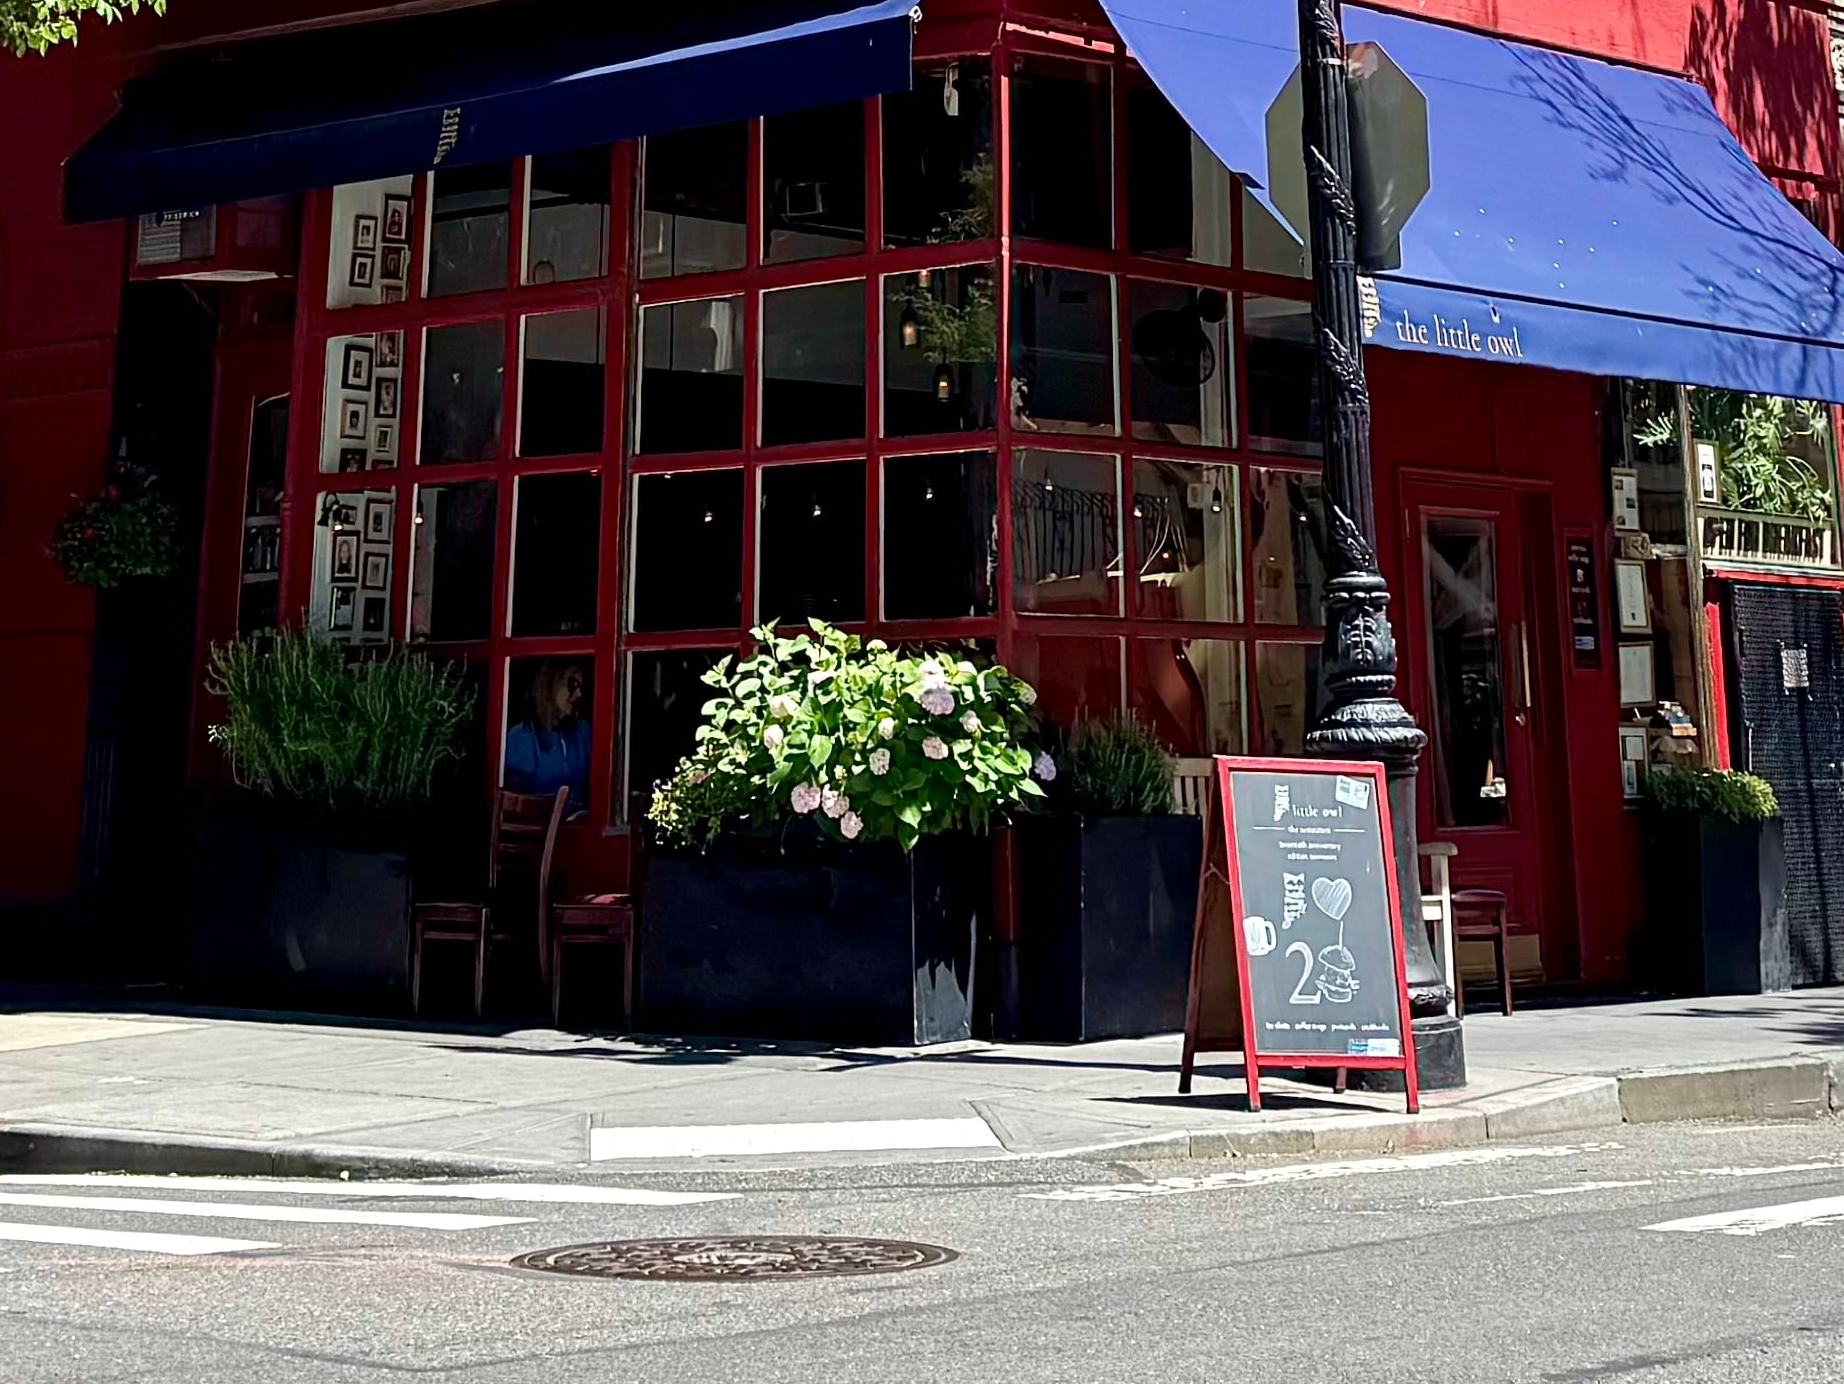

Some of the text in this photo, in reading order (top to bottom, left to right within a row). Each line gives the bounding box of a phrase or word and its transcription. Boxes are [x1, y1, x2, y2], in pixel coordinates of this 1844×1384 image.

[1395, 309, 1523, 358] the little owl
[1292, 804, 1343, 818] little owl
